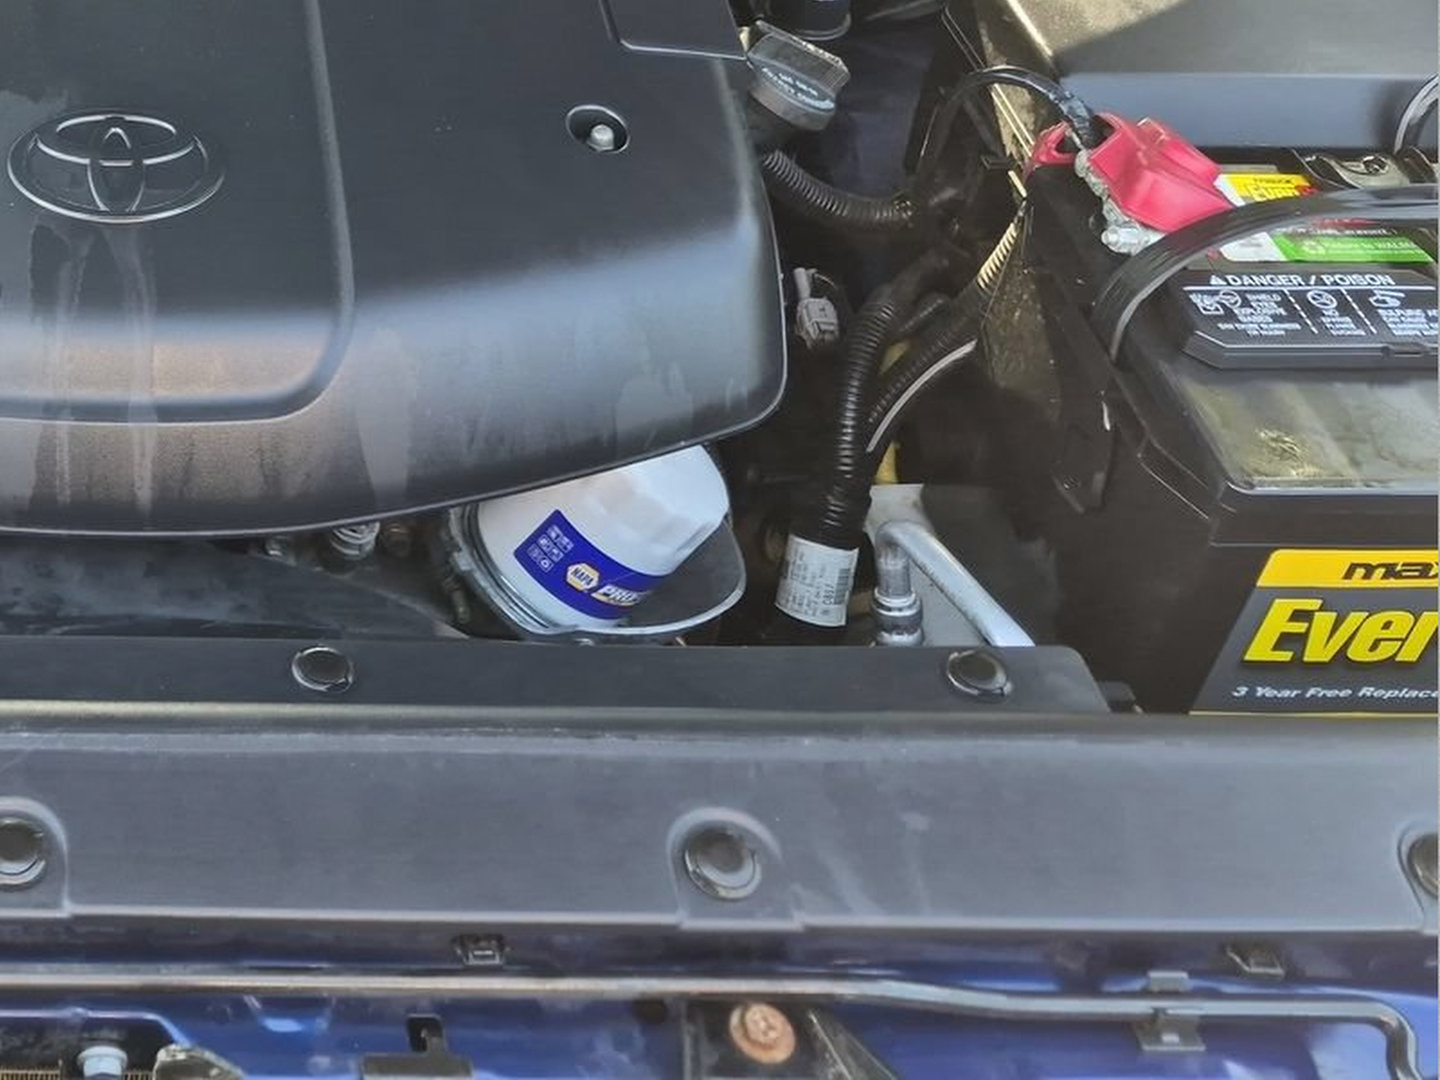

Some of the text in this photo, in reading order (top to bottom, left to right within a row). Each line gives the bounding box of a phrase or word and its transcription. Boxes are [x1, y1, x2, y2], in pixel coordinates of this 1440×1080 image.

[1226, 275, 1303, 286] DANGER
[1323, 275, 1396, 286] POISON
[571, 567, 594, 586] NAPA
[1342, 562, 1438, 580] ma
[1232, 686, 1249, 698] 3
[1255, 686, 1301, 698] Year
[1305, 686, 1353, 698] Free
